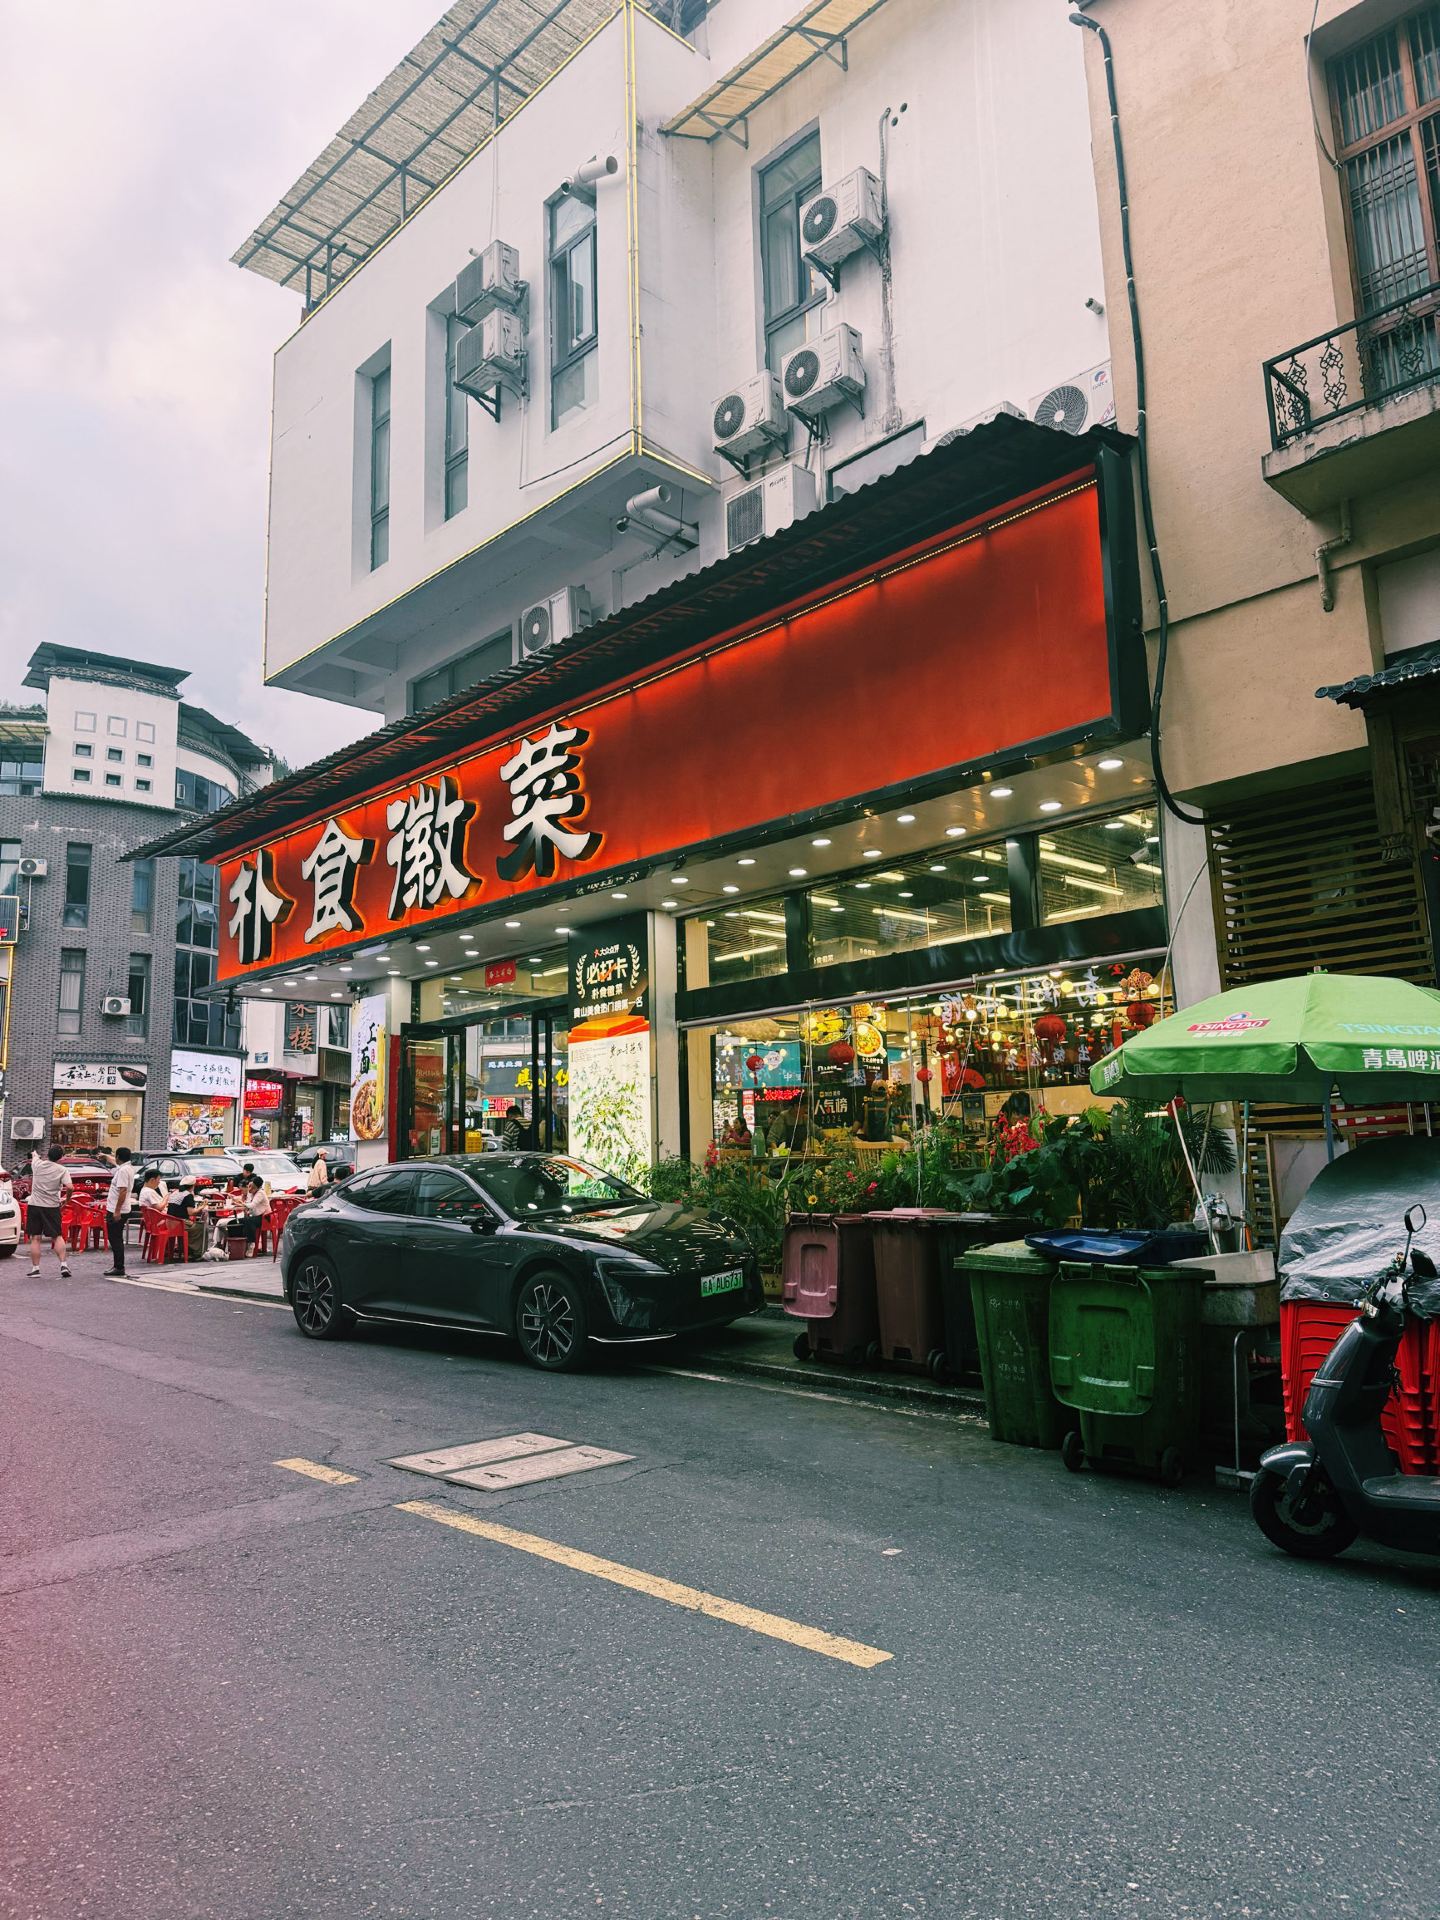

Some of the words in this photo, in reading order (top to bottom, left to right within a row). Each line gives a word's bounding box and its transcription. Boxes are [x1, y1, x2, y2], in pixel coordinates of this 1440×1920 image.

[229, 723, 592, 964] 朴食徽菜
[586, 957, 629, 985] 必打卡
[1196, 1020, 1264, 1031] TSINGTAO
[1336, 1022, 1440, 1035] TSINGTA
[814, 1097, 848, 1115] 人气榜
